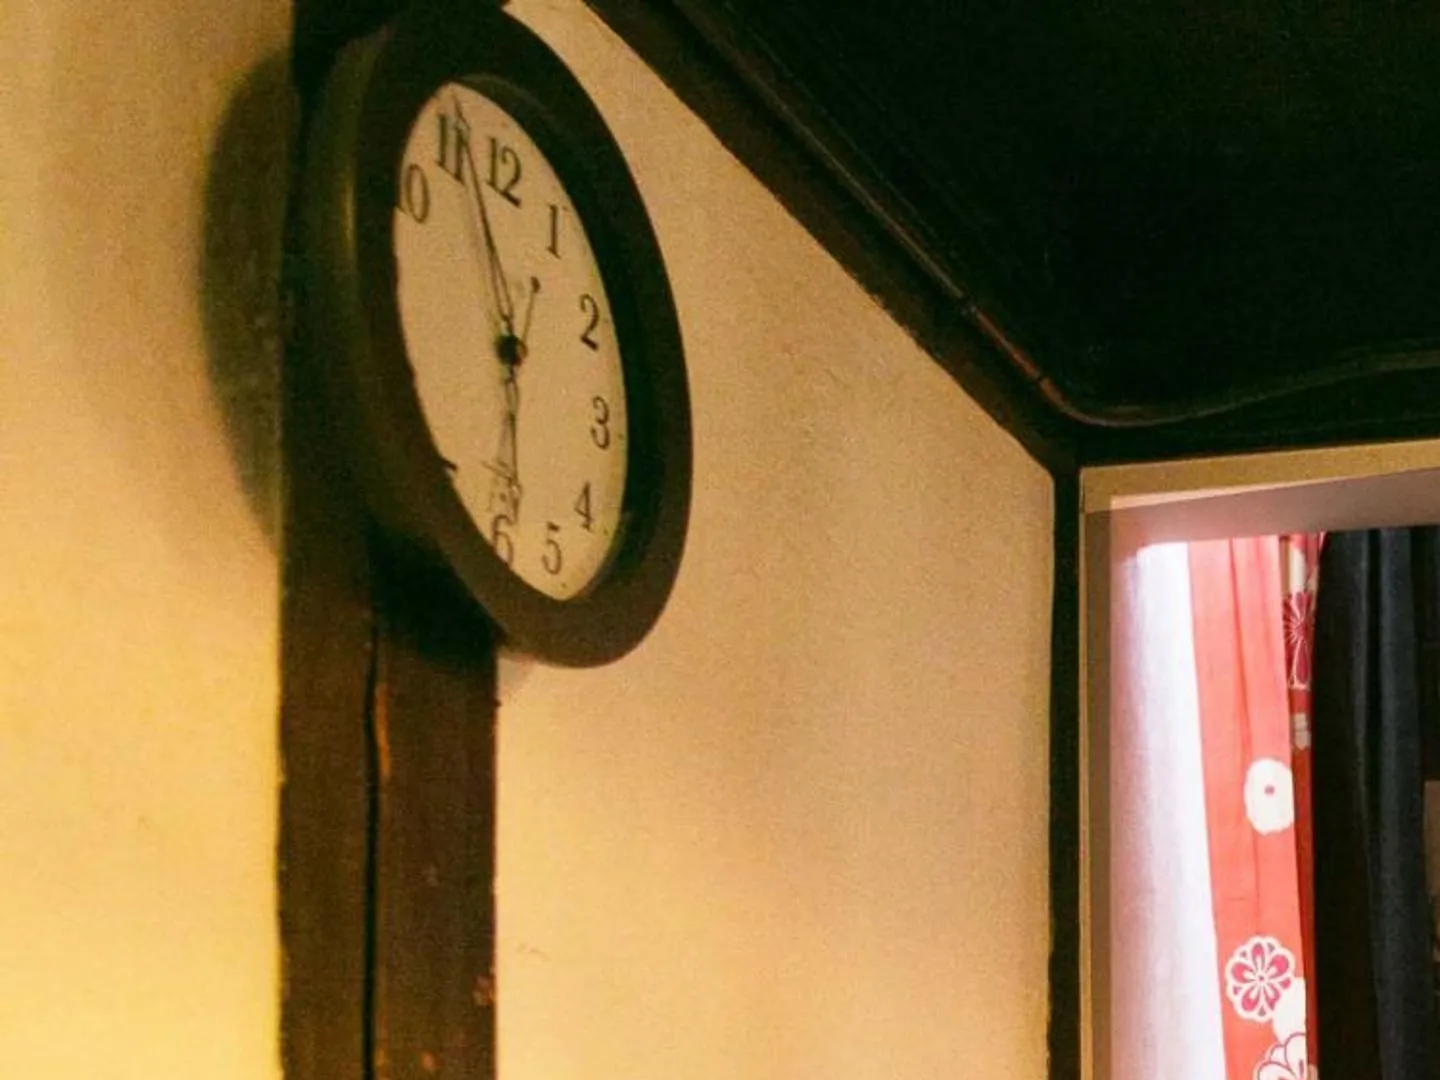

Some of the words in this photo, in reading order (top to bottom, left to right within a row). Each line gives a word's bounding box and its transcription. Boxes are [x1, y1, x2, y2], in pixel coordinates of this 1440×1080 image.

[435, 113, 466, 186] 11
[487, 136, 522, 209] 12
[394, 164, 430, 223] 0
[546, 203, 561, 259] 1
[580, 293, 599, 351] 2
[591, 396, 610, 450] 3
[573, 481, 593, 532] 4
[492, 514, 517, 571] 6
[542, 522, 562, 575] 5
